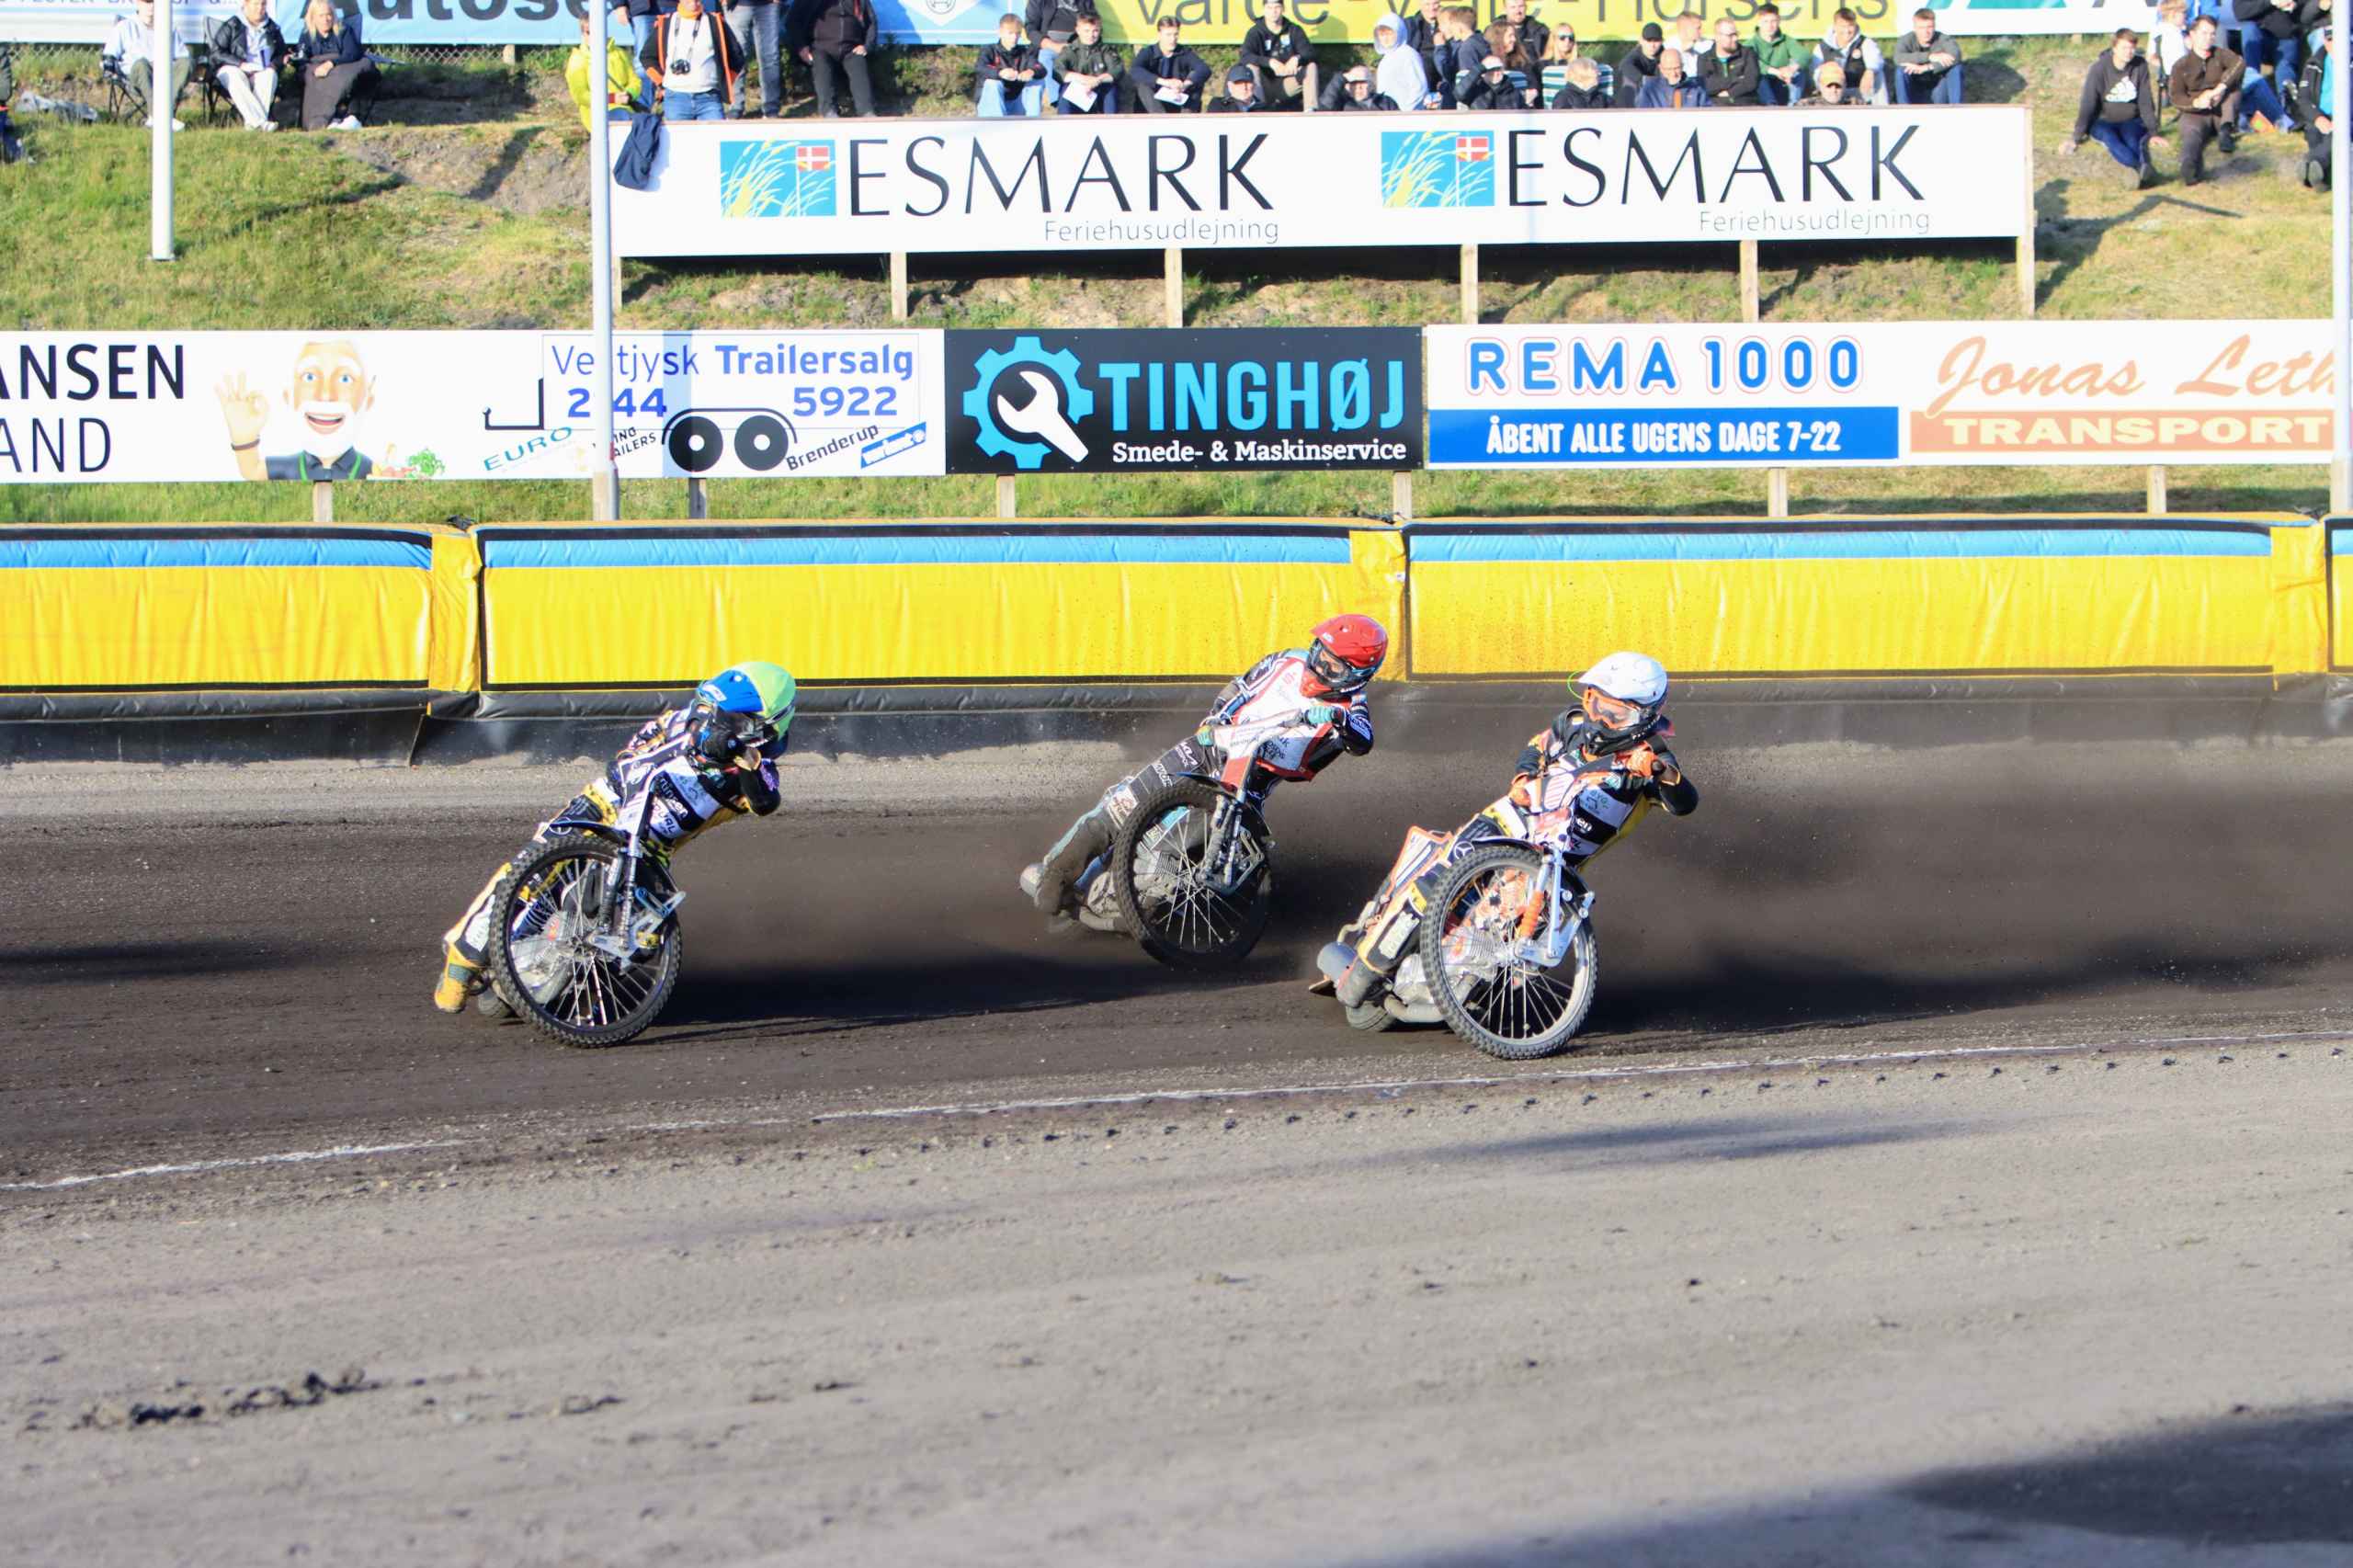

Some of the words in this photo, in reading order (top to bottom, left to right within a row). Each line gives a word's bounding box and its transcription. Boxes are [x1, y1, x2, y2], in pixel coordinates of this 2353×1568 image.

[850, 133, 1274, 216] ESMARK
[1508, 125, 1925, 208] ESMARK
[1045, 219, 1279, 244] Feriehusudlejning
[1700, 210, 1931, 235] Feriehusudlejning
[0, 344, 184, 401] NSEN
[551, 344, 699, 382] Vetjysk
[715, 344, 913, 381] Trailersalg
[1469, 339, 1678, 392] REMA
[1703, 337, 1860, 390] 1000
[1925, 335, 2145, 417] Jonas
[568, 388, 667, 418] 244
[793, 386, 898, 416] 5922
[1098, 358, 1404, 432] TINGHØJ
[483, 426, 572, 471] EURO
[786, 425, 880, 471] Brenderup
[1112, 439, 1204, 463] Smede-
[1210, 440, 1229, 462] &
[1234, 437, 1407, 461] Maskinservice
[1486, 415, 1564, 454] ÅBENT
[1570, 422, 1626, 453] ALLE
[1631, 422, 1711, 453] UGENS
[1719, 421, 1780, 452] DAGE
[1787, 420, 1841, 452] 7-22
[1943, 416, 2329, 445] TRANSPORT
